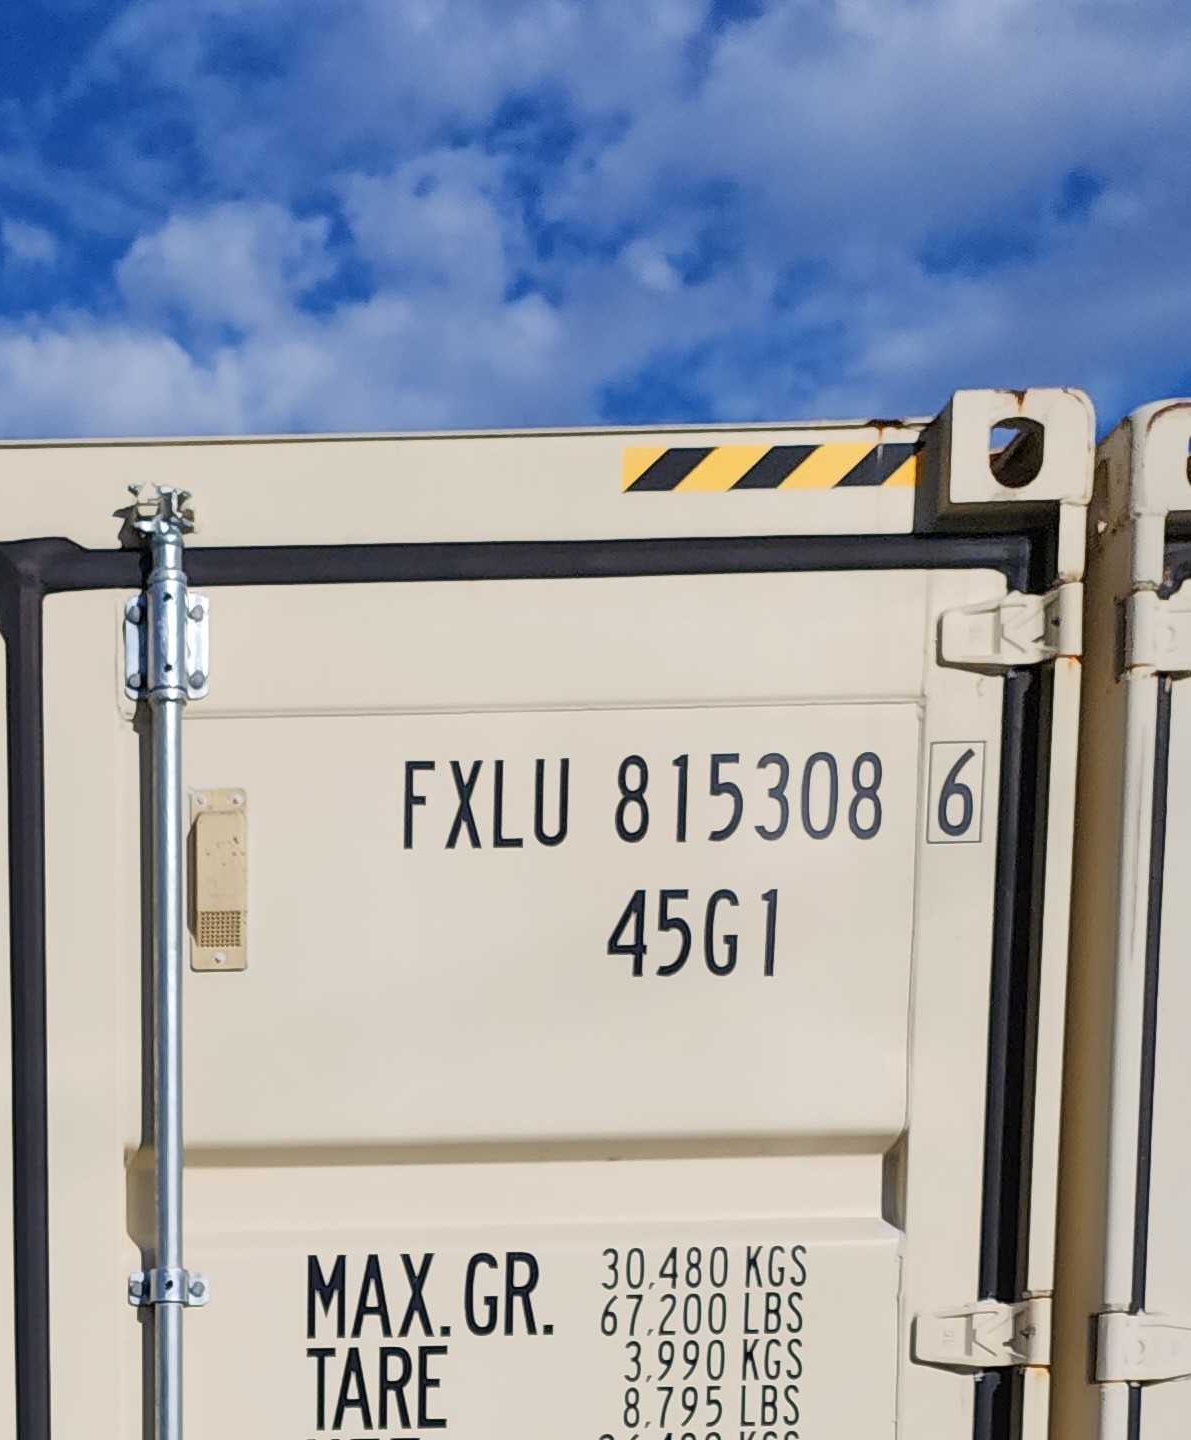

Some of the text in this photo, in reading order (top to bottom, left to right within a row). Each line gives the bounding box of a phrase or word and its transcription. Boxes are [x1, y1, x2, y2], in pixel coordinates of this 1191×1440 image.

[403, 748, 976, 850] FXLU 815308 6
[606, 888, 779, 978] 45G1
[601, 1244, 807, 1291] 30,480 KGS
[600, 1291, 803, 1338] 67,200 LBS
[624, 1338, 803, 1383] 3,990 KGS
[305, 1344, 449, 1432] TARE
[623, 1384, 800, 1430] 8,795 LBS
